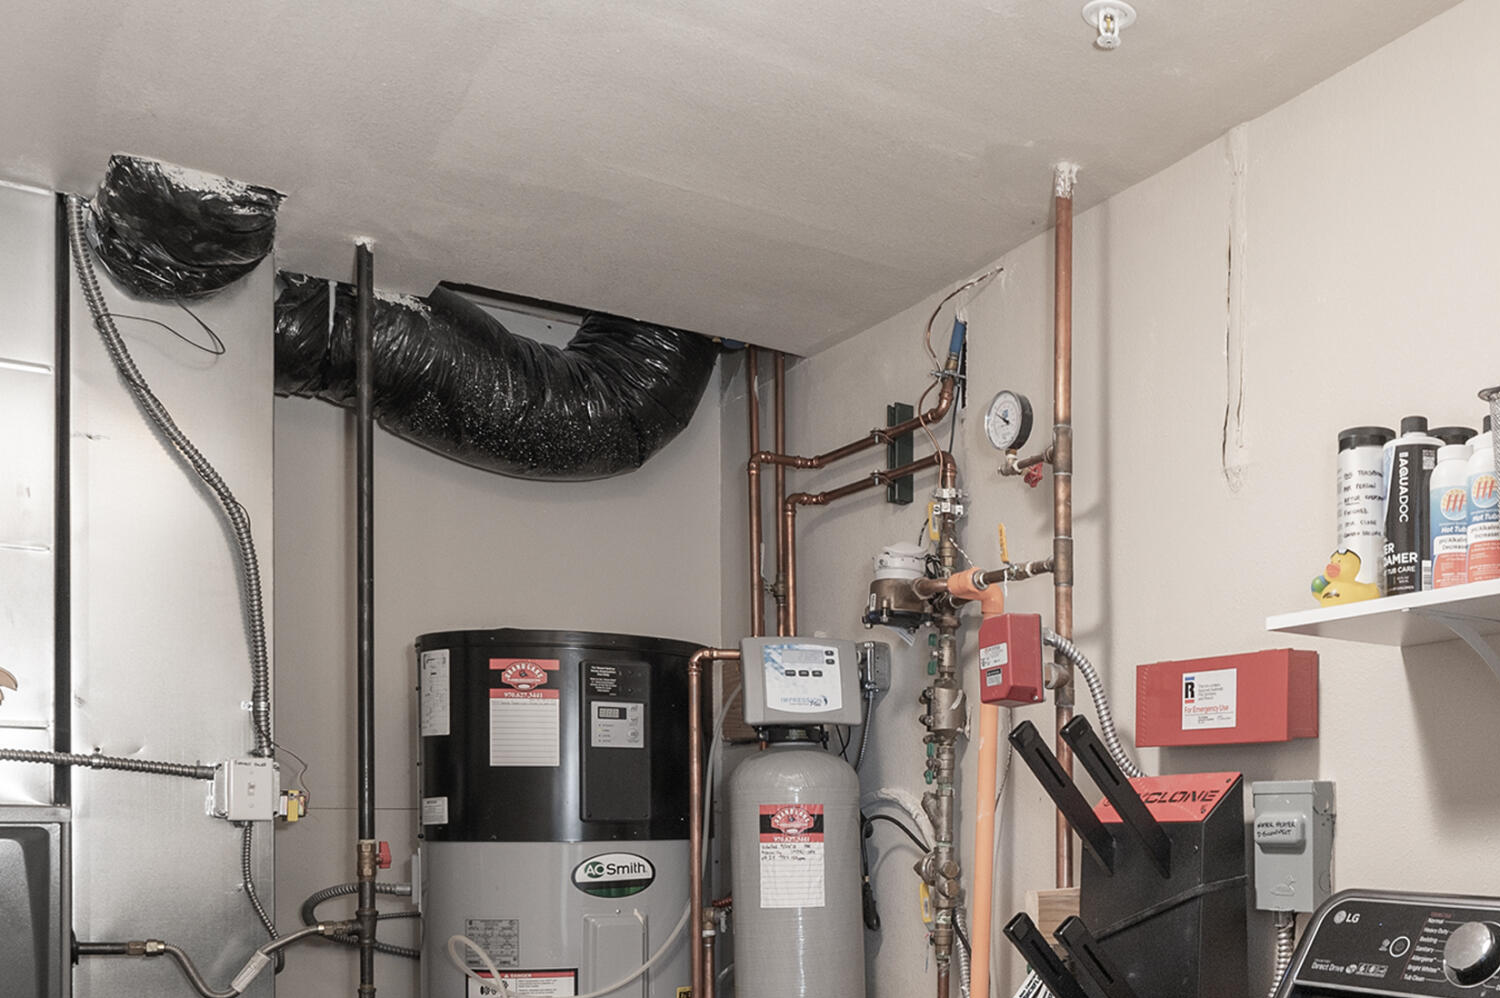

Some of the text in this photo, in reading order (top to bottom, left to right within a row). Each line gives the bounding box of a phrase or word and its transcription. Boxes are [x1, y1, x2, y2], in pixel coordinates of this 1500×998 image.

[1384, 552, 1418, 567] AMER
[1184, 682, 1195, 698] R
[606, 862, 646, 876] Smith
[1345, 912, 1361, 924] LG
